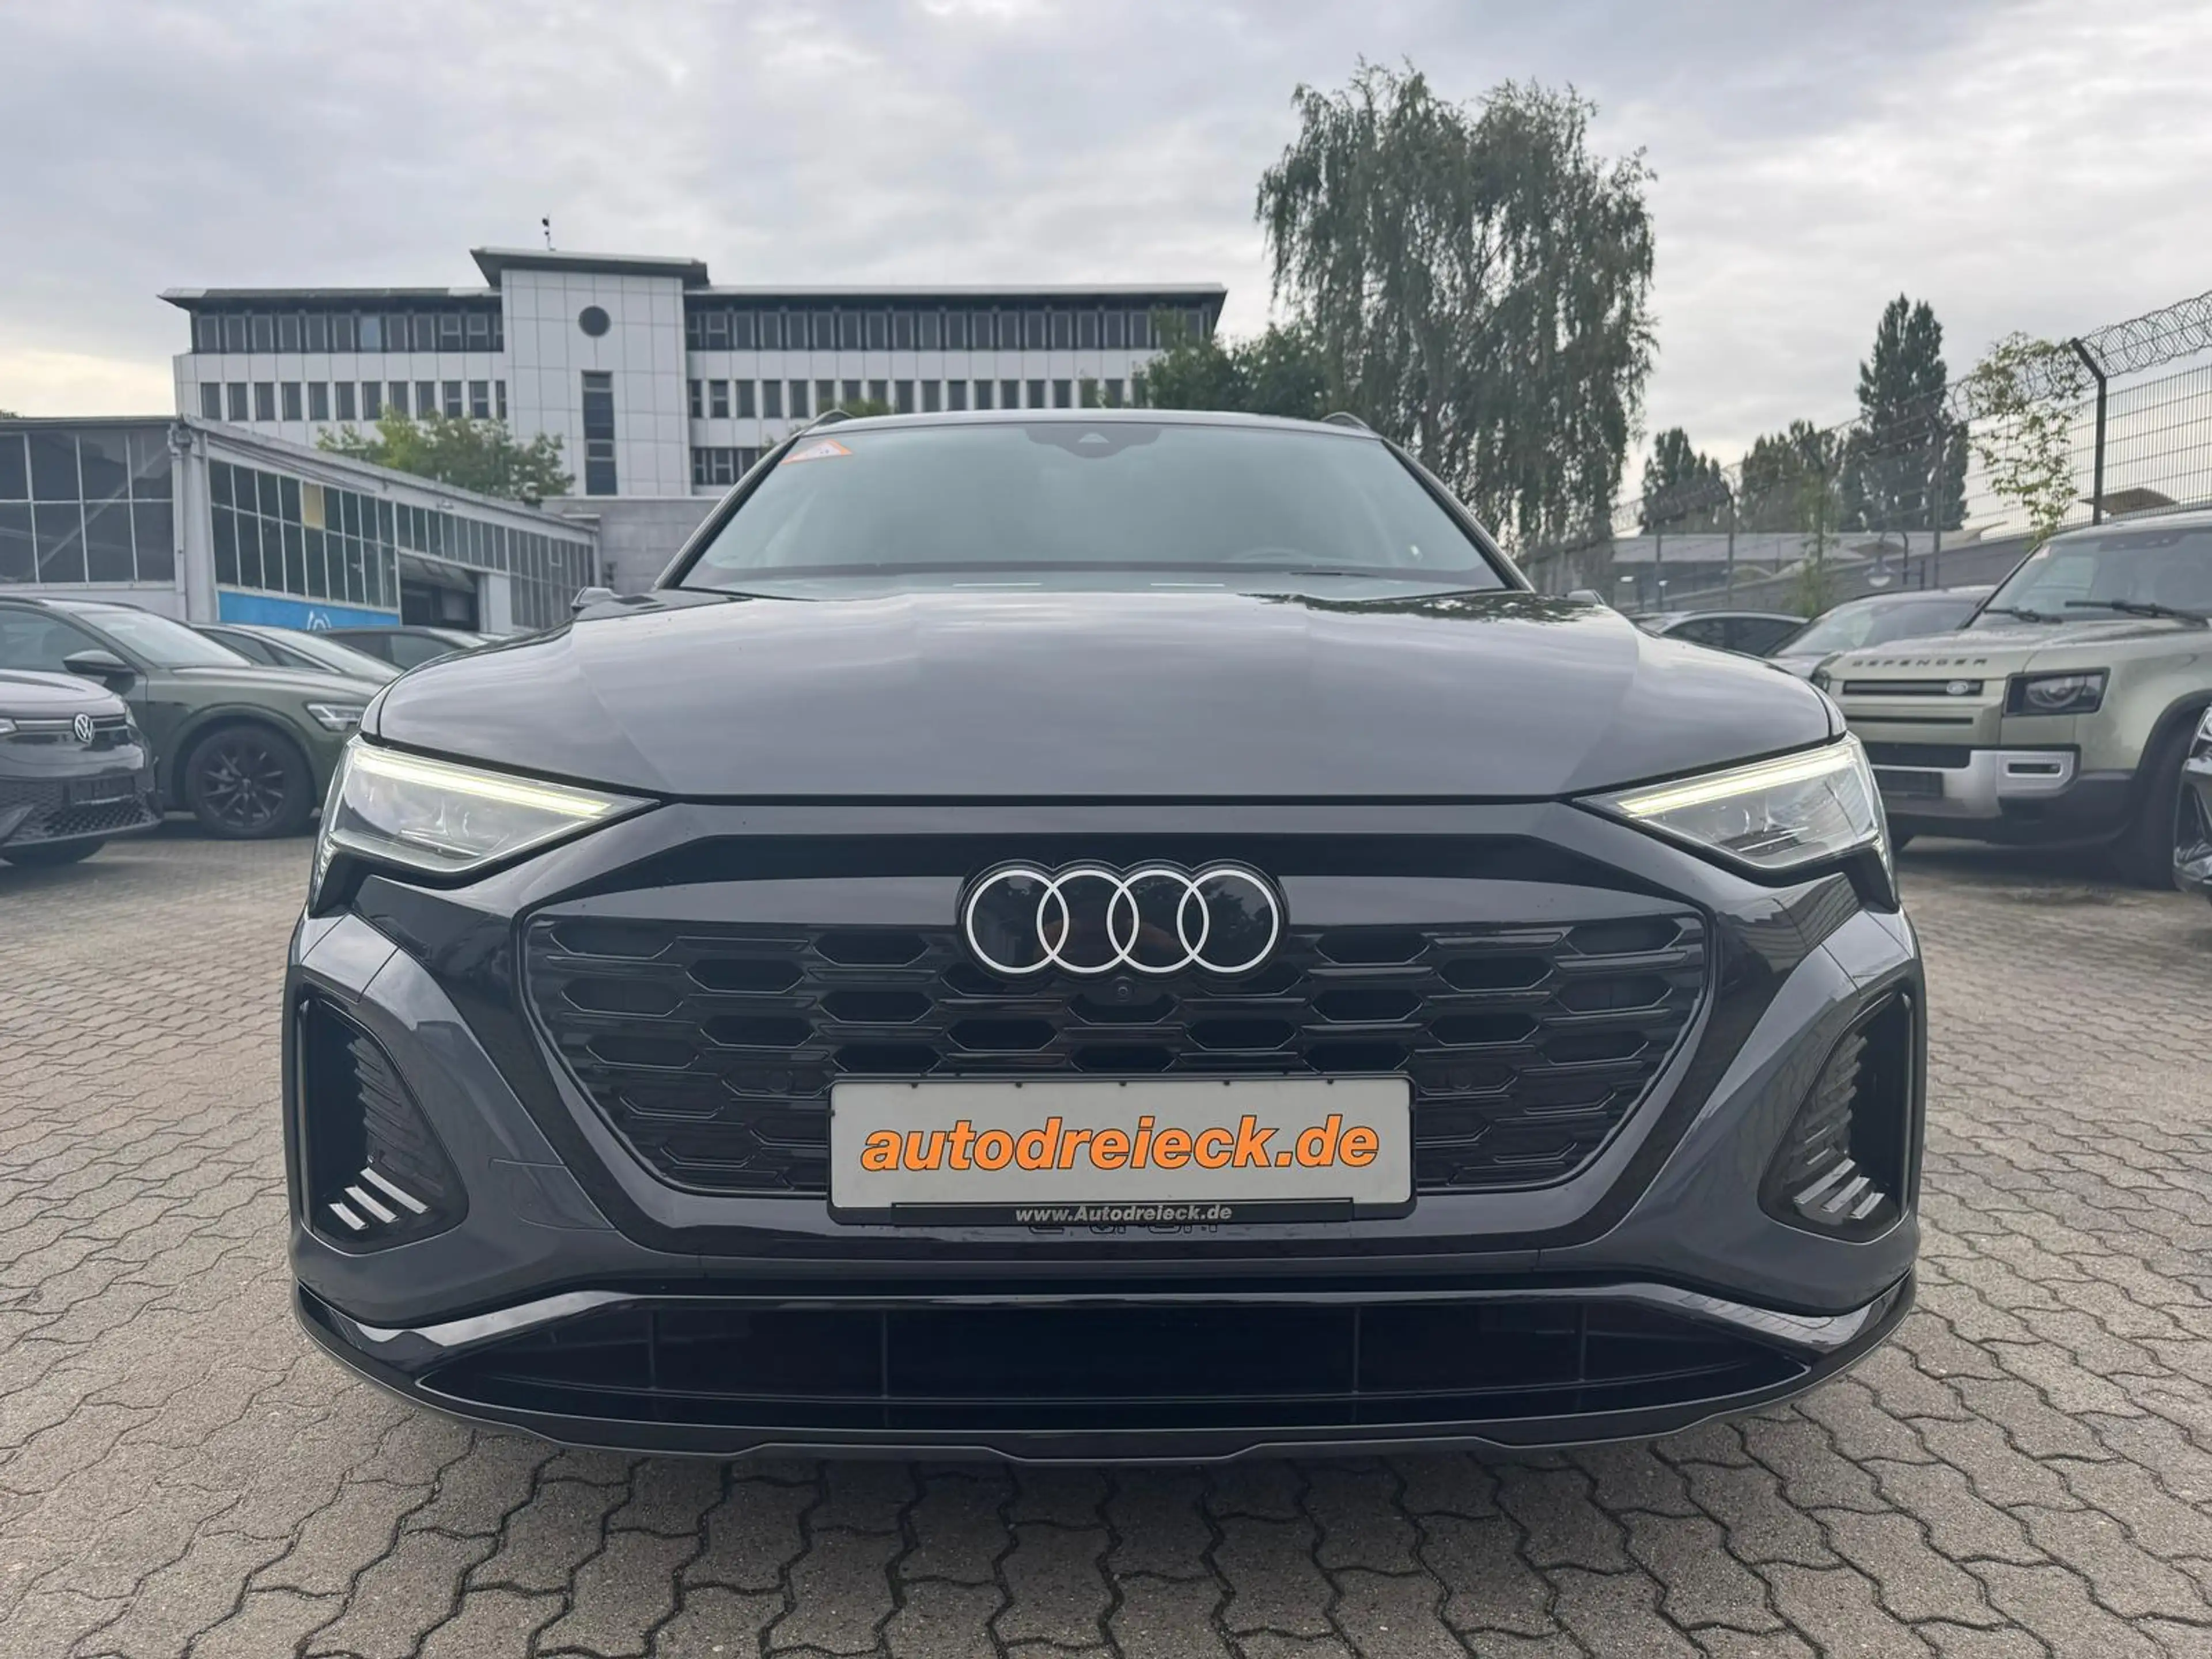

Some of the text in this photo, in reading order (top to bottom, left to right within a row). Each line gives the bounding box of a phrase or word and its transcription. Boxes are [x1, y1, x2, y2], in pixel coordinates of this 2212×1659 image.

[1852, 657, 1987, 667] DEFENDER
[861, 1113, 1380, 1172] autodreieck.de
[1015, 1204, 1233, 1222] www.Autodreieck.de
